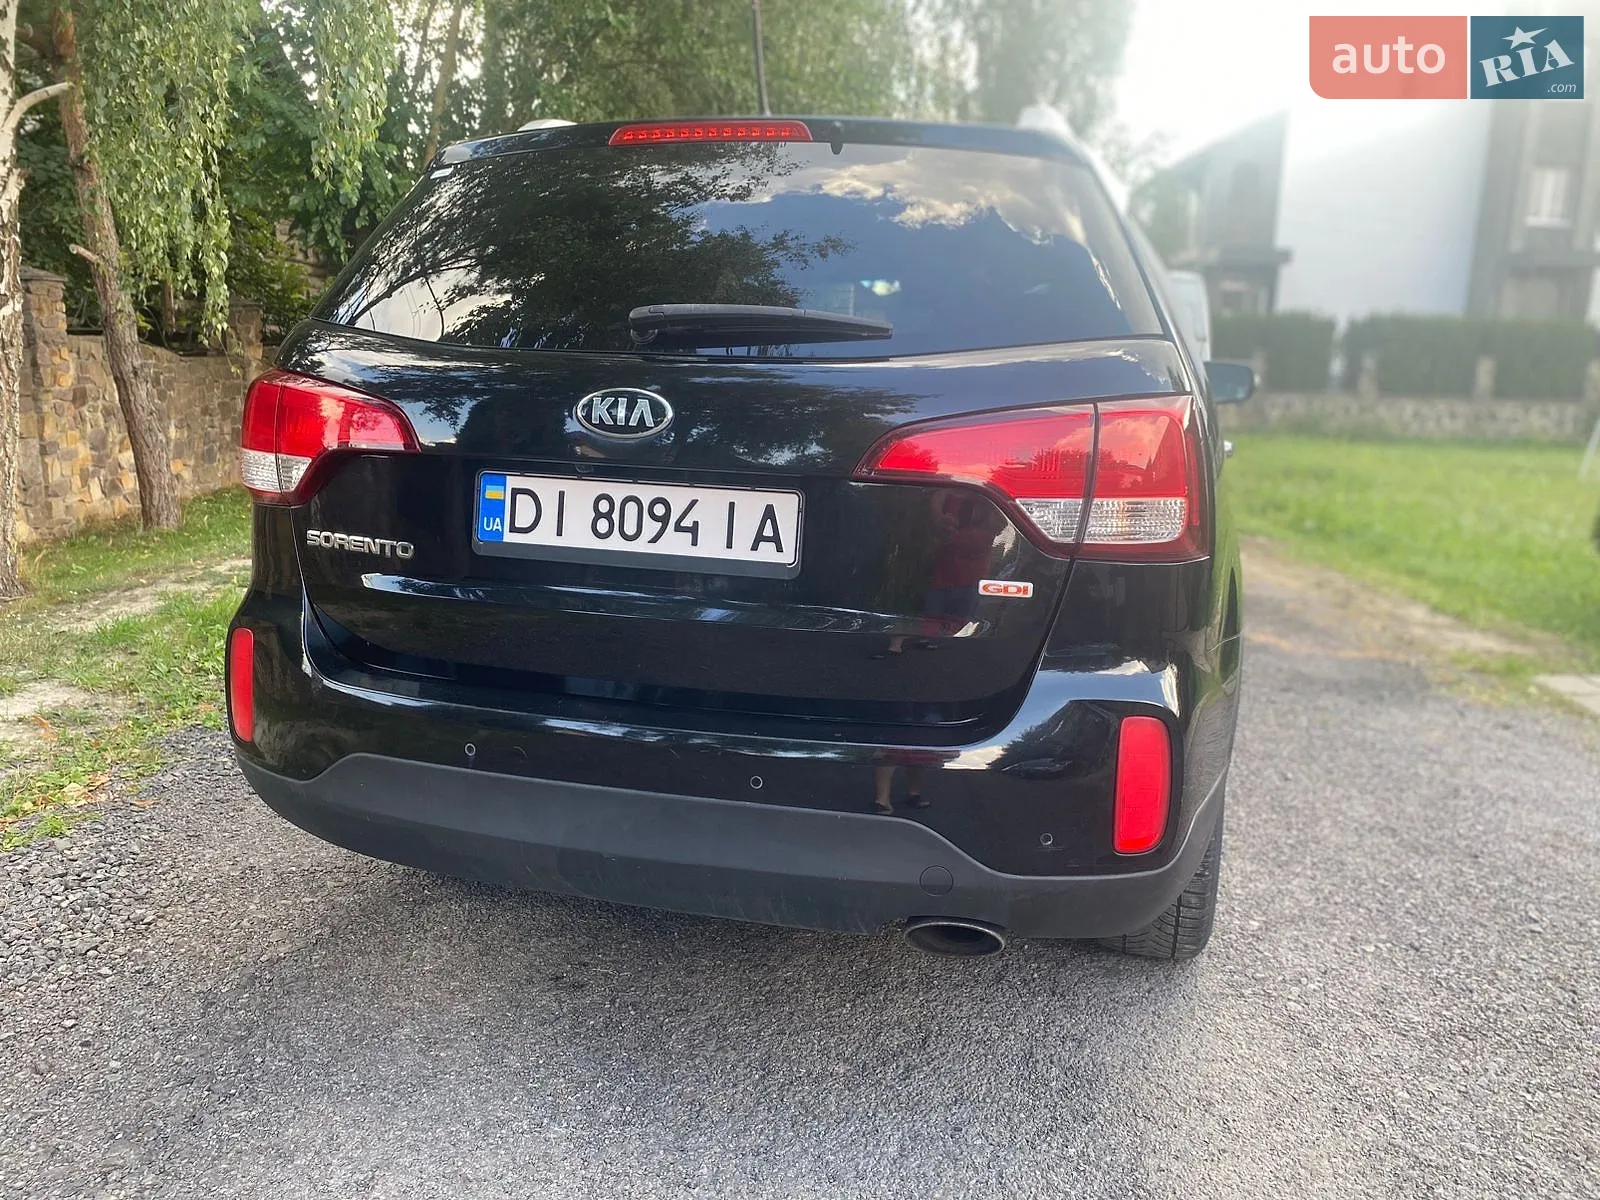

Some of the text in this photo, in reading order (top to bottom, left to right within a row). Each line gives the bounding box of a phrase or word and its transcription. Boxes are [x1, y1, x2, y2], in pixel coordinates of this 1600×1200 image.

[591, 397, 655, 428] KIA
[483, 517, 503, 532] UA
[508, 487, 784, 553] DI 8094 IA
[306, 529, 415, 560] SORENTO
[982, 583, 1029, 595] GDI
